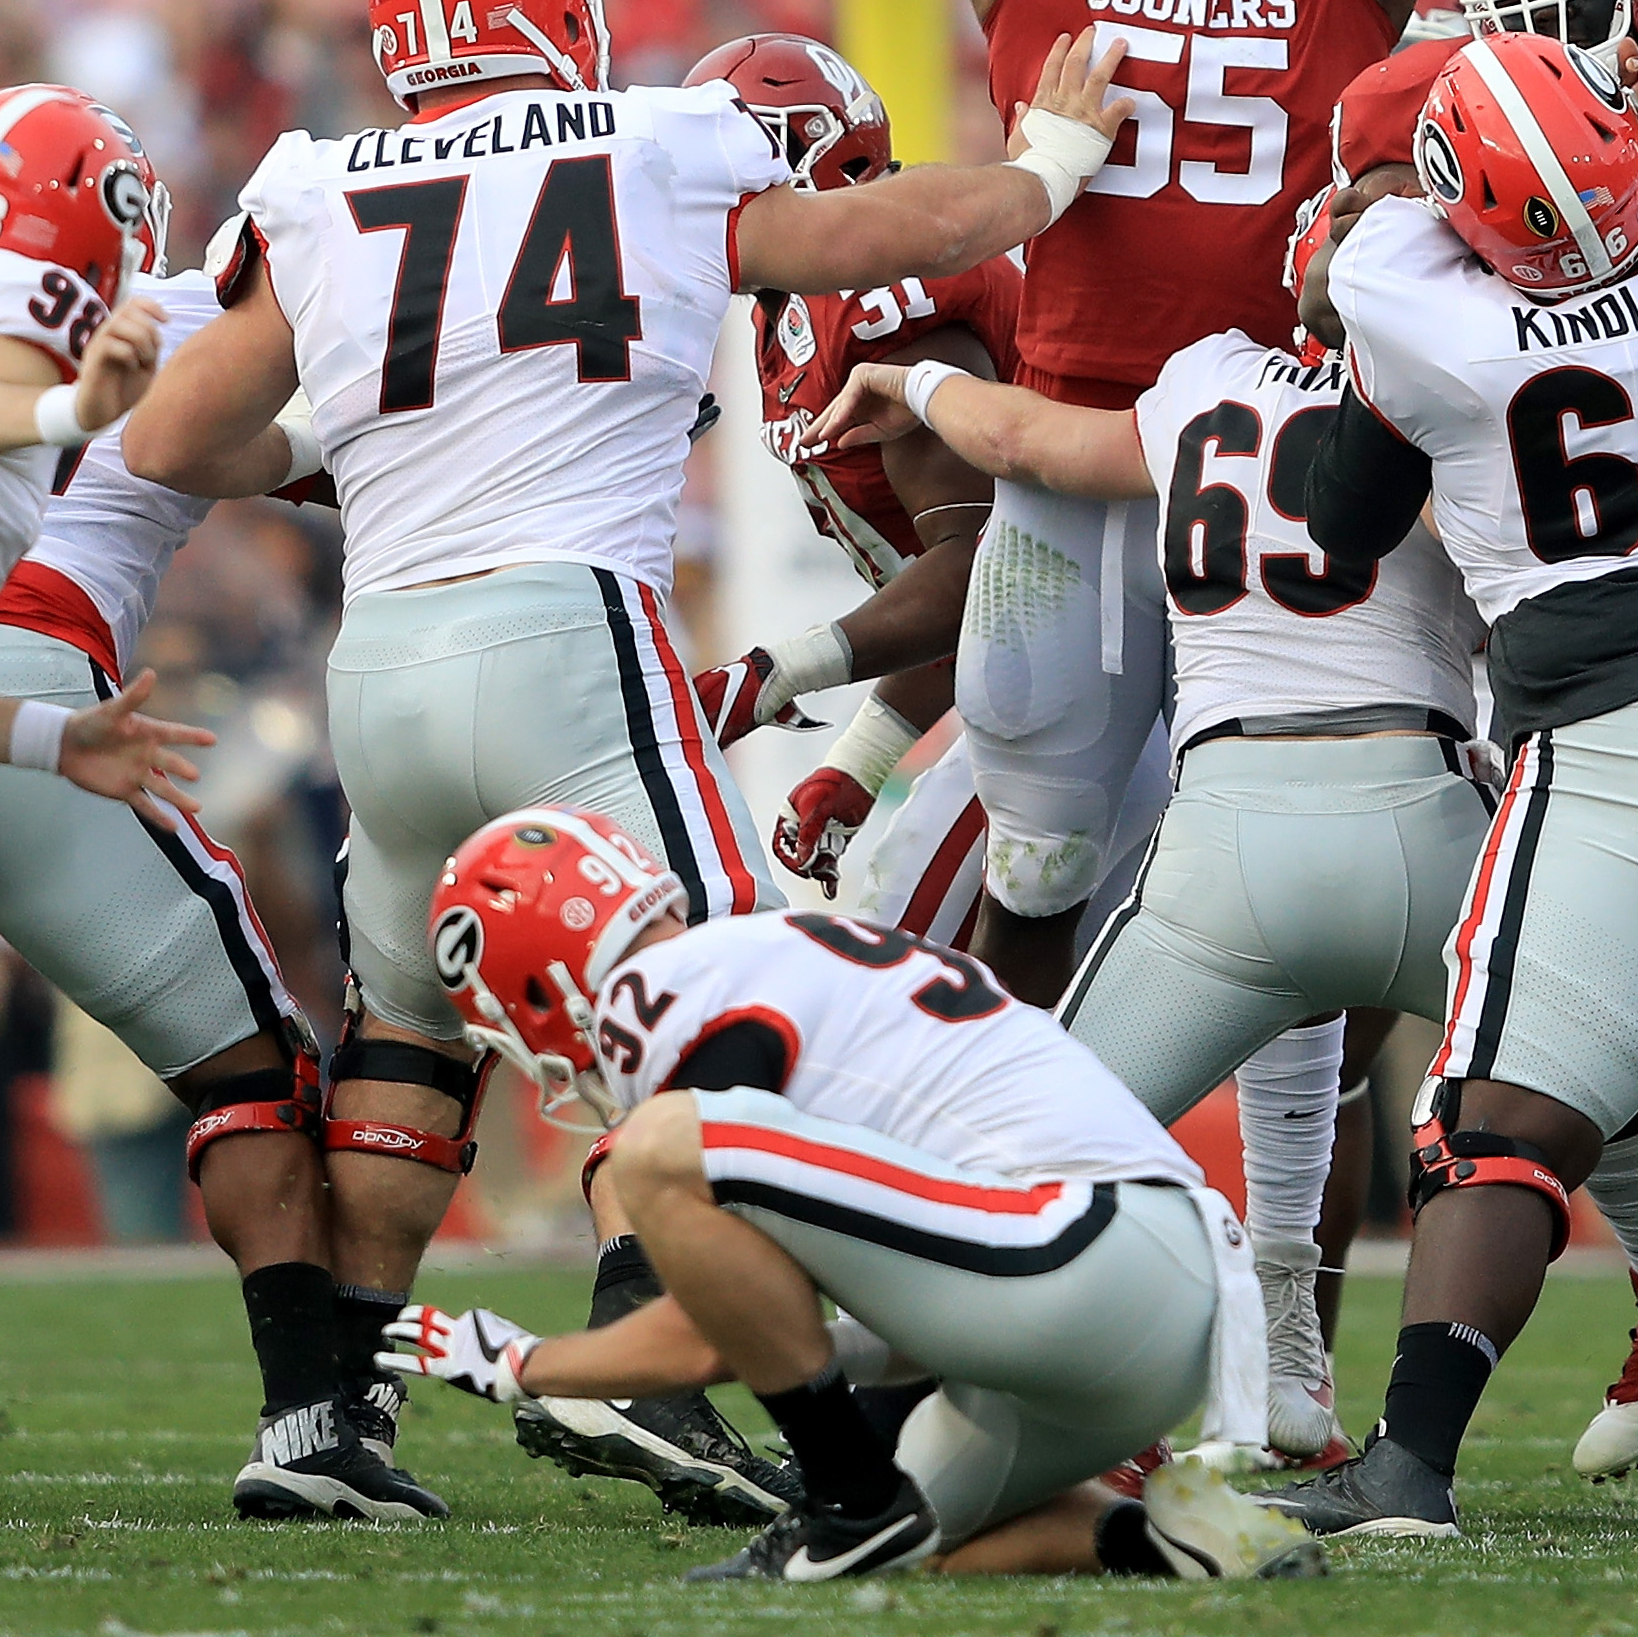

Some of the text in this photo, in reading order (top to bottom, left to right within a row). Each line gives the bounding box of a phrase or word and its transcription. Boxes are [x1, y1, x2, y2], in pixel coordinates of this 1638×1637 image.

[406, 62, 483, 87] GEORGIA
[1085, 20, 1289, 205] 55
[346, 100, 616, 173] CLEVELAND
[28, 271, 109, 358] 98
[343, 152, 642, 415] 74
[1164, 399, 1378, 618] 69
[599, 972, 678, 1075] 92
[352, 1128, 424, 1150] DONJOY
[262, 1399, 339, 1466] NIKE
